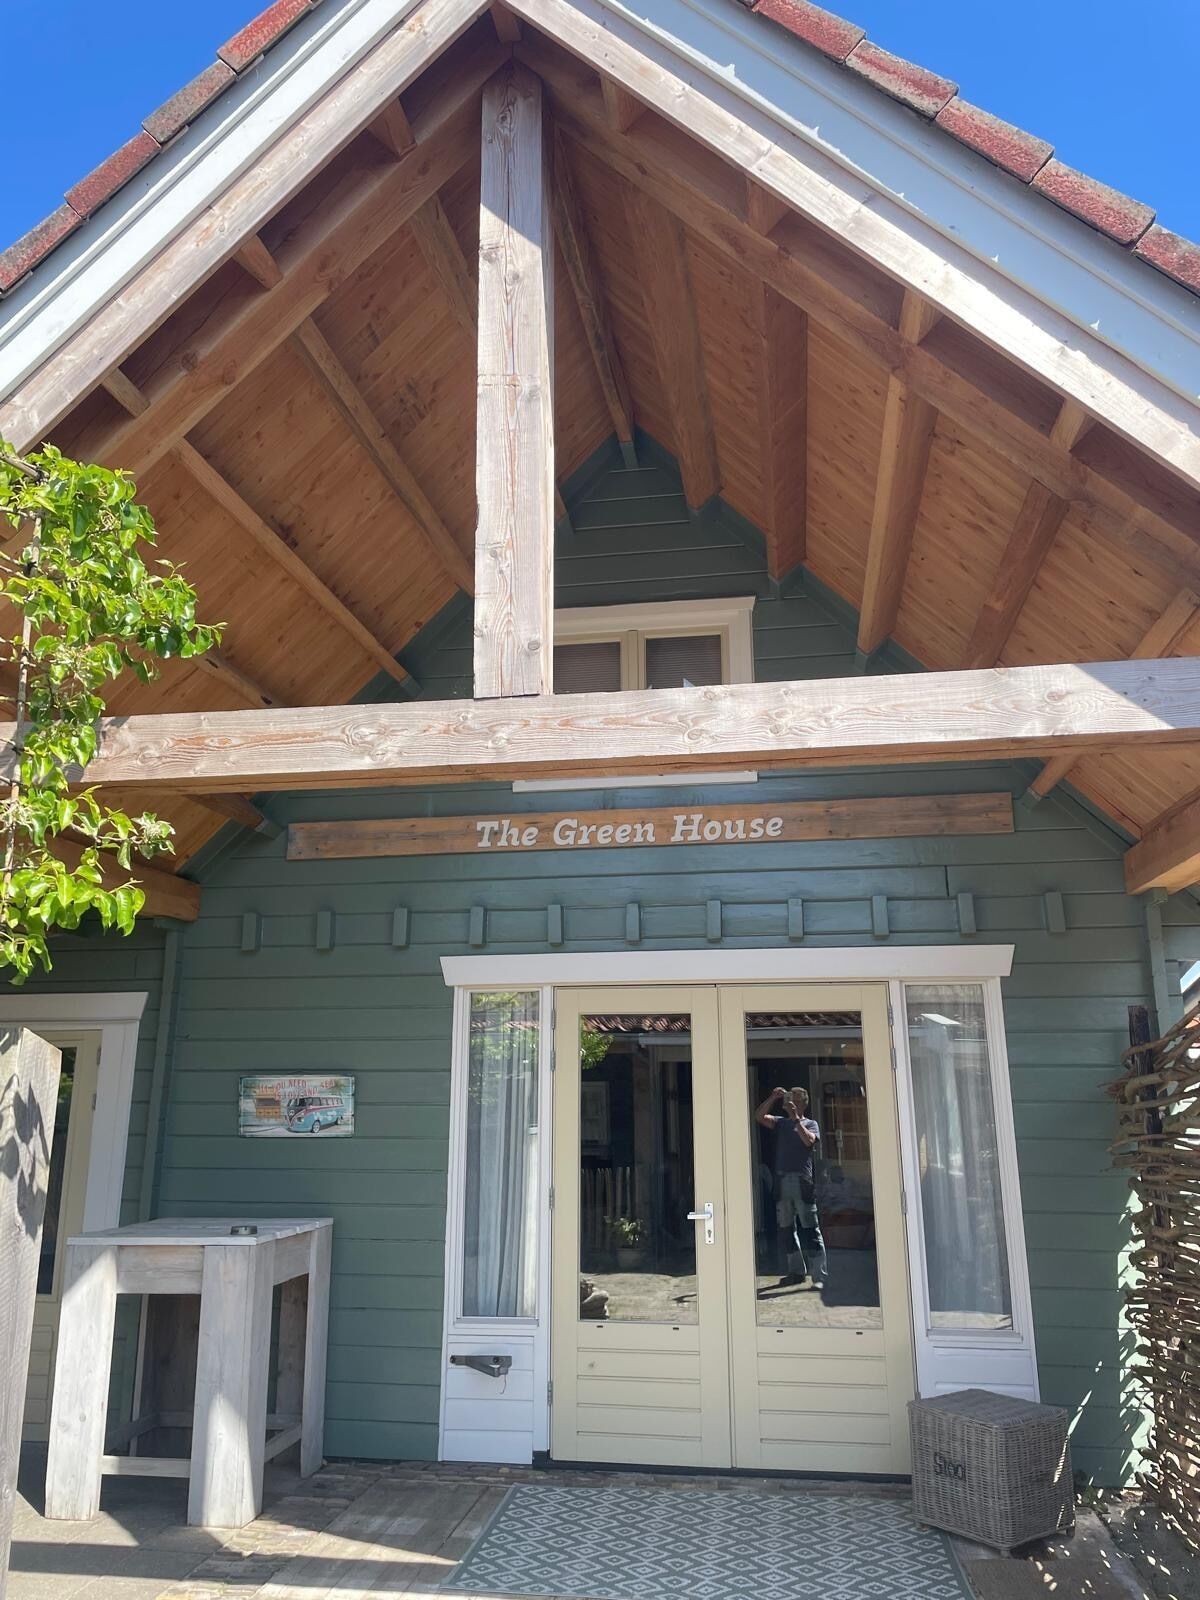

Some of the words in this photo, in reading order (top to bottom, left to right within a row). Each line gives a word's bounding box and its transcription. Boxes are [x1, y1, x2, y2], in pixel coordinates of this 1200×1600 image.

[476, 819, 539, 849] The
[553, 817, 656, 845] Green
[670, 813, 784, 843] House
[288, 1078, 307, 1088] NEED
